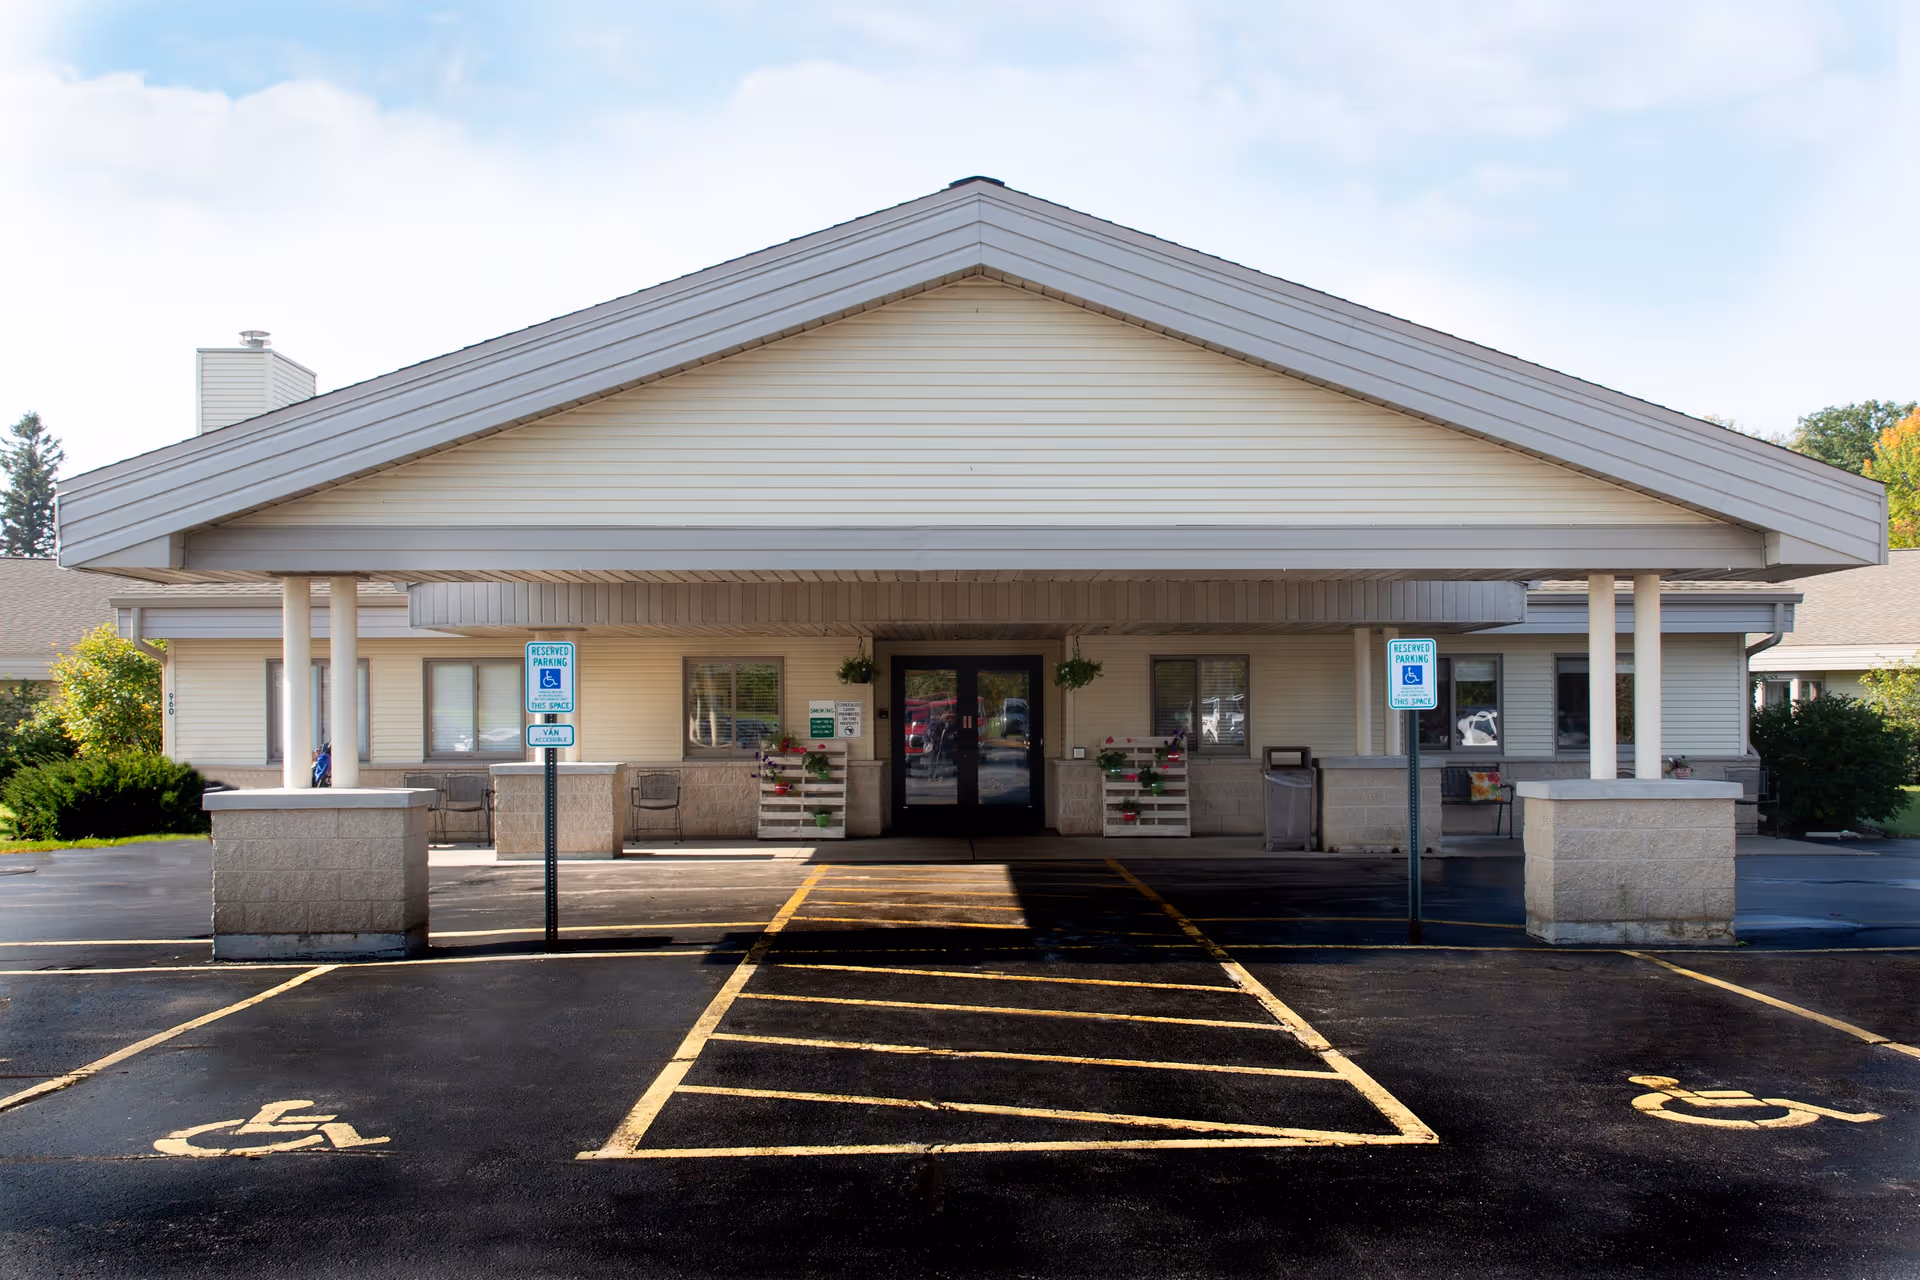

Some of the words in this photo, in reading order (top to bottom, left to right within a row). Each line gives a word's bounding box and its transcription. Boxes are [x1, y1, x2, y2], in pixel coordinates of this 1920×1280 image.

[531, 646, 569, 656] RESERVED
[1393, 643, 1430, 652] RESERVED
[533, 657, 567, 667] PARKING
[1395, 654, 1429, 663] PARKING
[1412, 697, 1432, 705] SPACE
